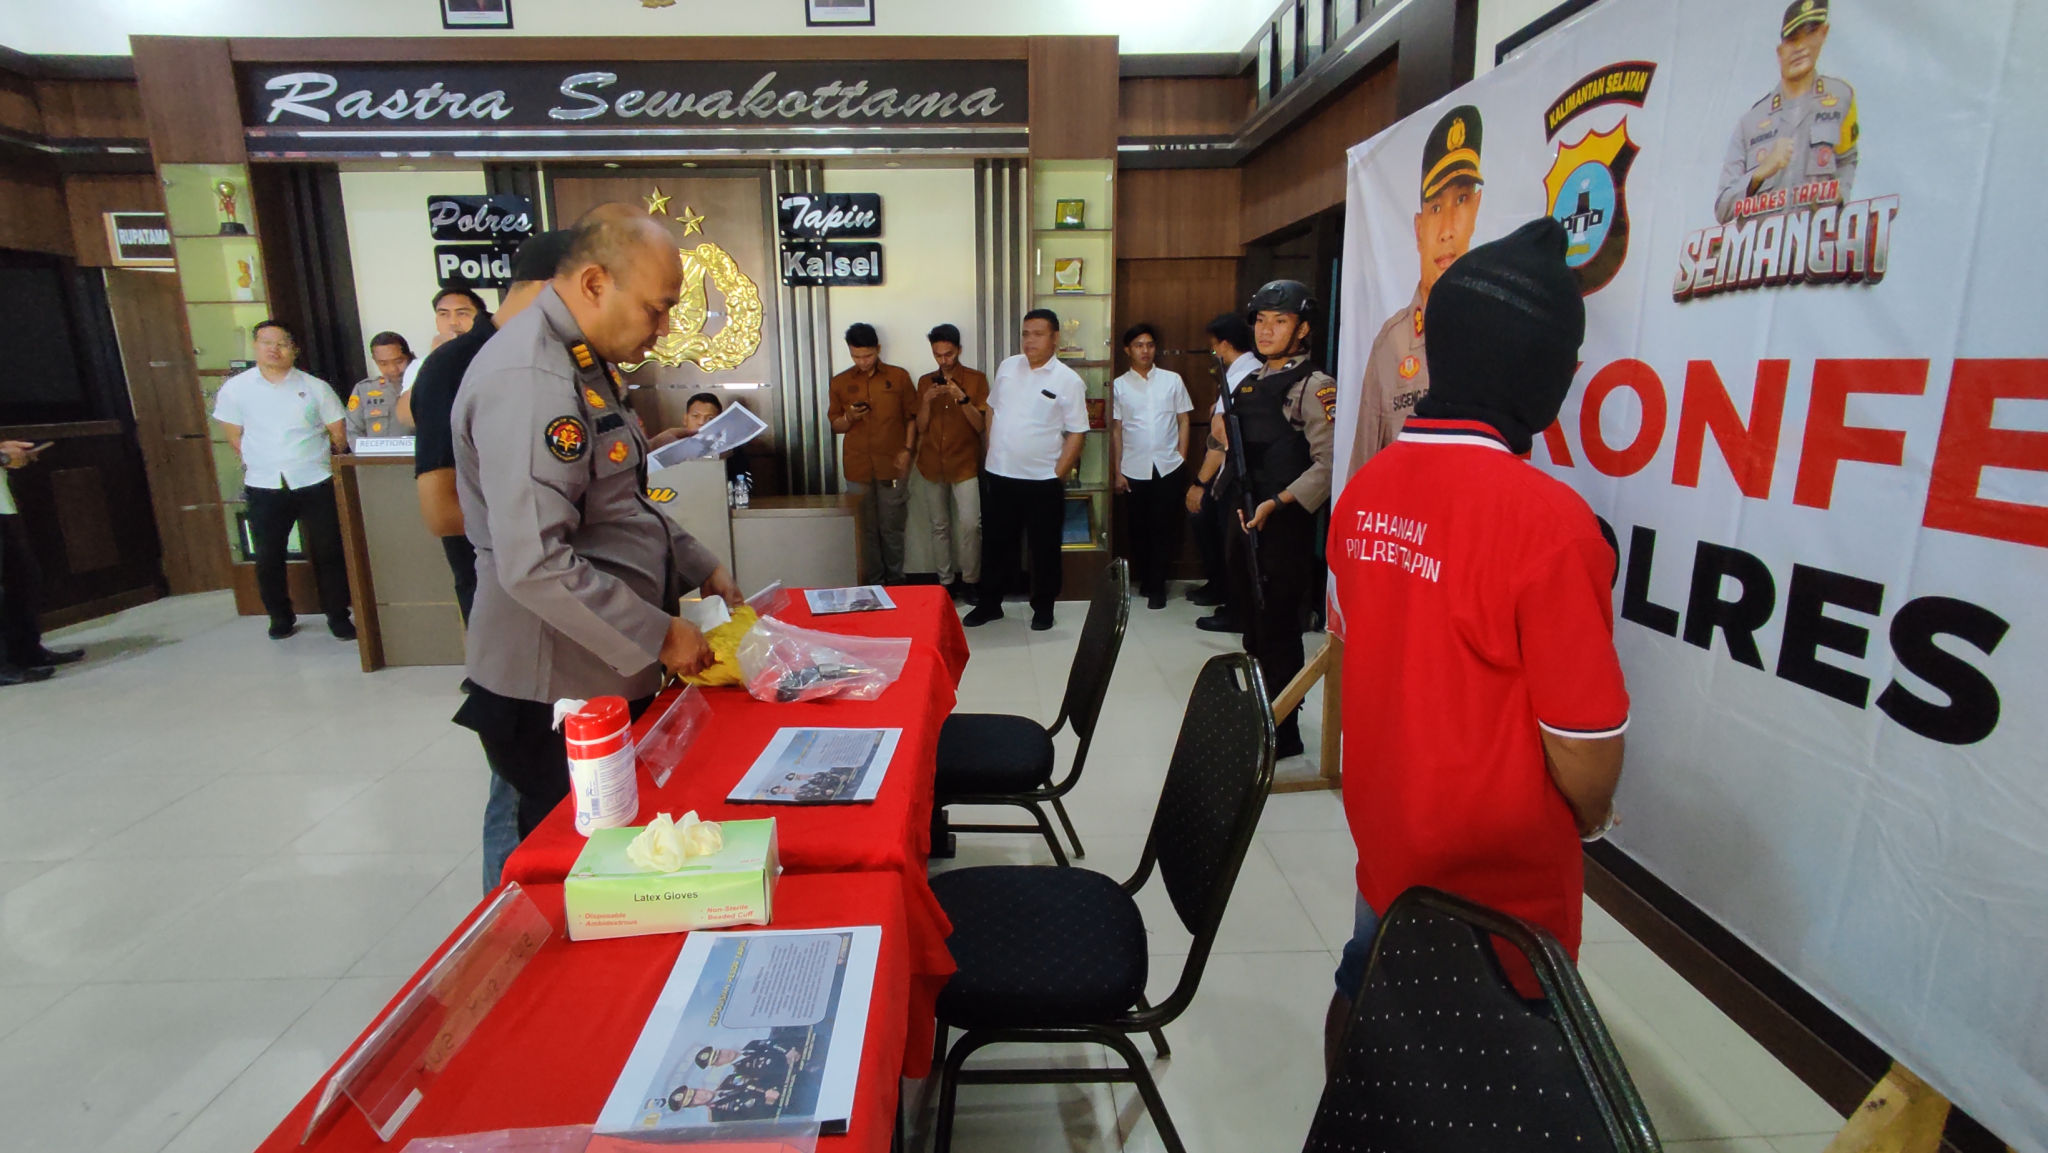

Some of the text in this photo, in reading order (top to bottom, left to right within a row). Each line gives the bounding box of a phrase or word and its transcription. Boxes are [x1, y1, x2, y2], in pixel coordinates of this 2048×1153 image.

[265, 71, 1004, 122] Rastra Sewakottama
[1549, 71, 1649, 129] KALIMANTAN SELATAN
[429, 201, 533, 234] Polres
[782, 196, 876, 236] Tapin
[1734, 180, 1839, 217] POLRES TAPIN
[783, 251, 879, 277] Kalsel
[1672, 194, 1899, 303] SEMANGAT
[1522, 358, 2048, 549] ONFE
[1357, 511, 1428, 546] TAHANAN
[1346, 538, 1441, 583] POLRES TAPIN
[1594, 513, 2010, 745] LRES
[634, 891, 698, 902] Latex Gloves
